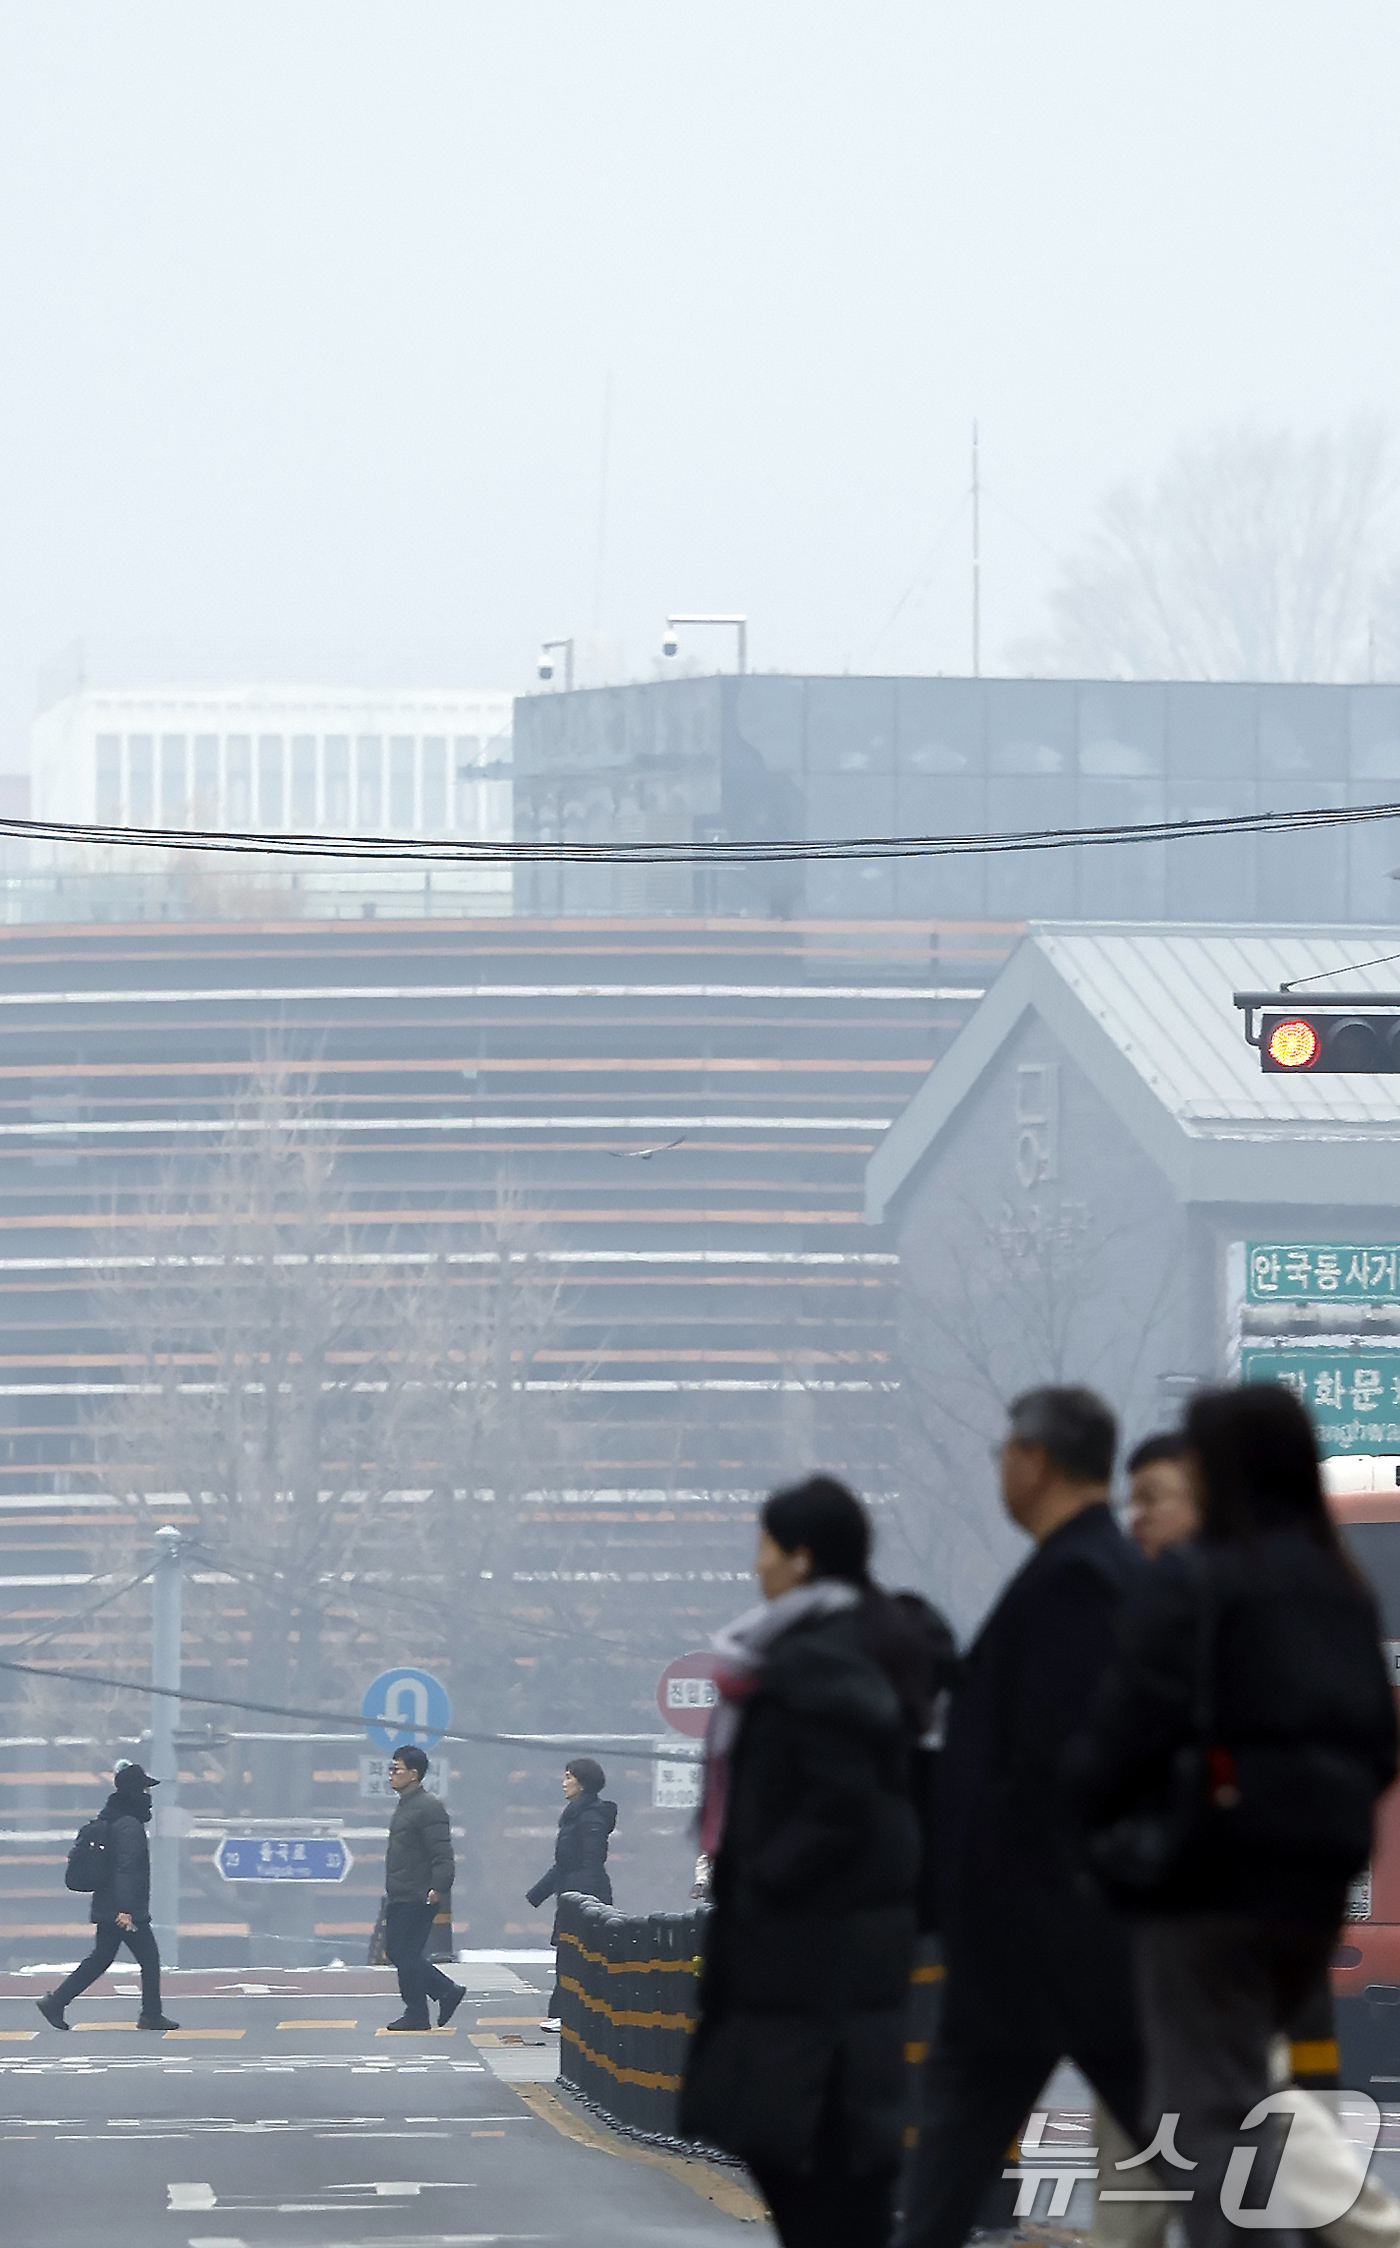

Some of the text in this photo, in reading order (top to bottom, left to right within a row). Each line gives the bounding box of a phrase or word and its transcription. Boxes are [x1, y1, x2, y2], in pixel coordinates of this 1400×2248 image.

[1255, 1251, 1400, 1290] 안국동사거
[1276, 1369, 1400, 1412] 광화문
[669, 1681, 717, 1704] 진입금
